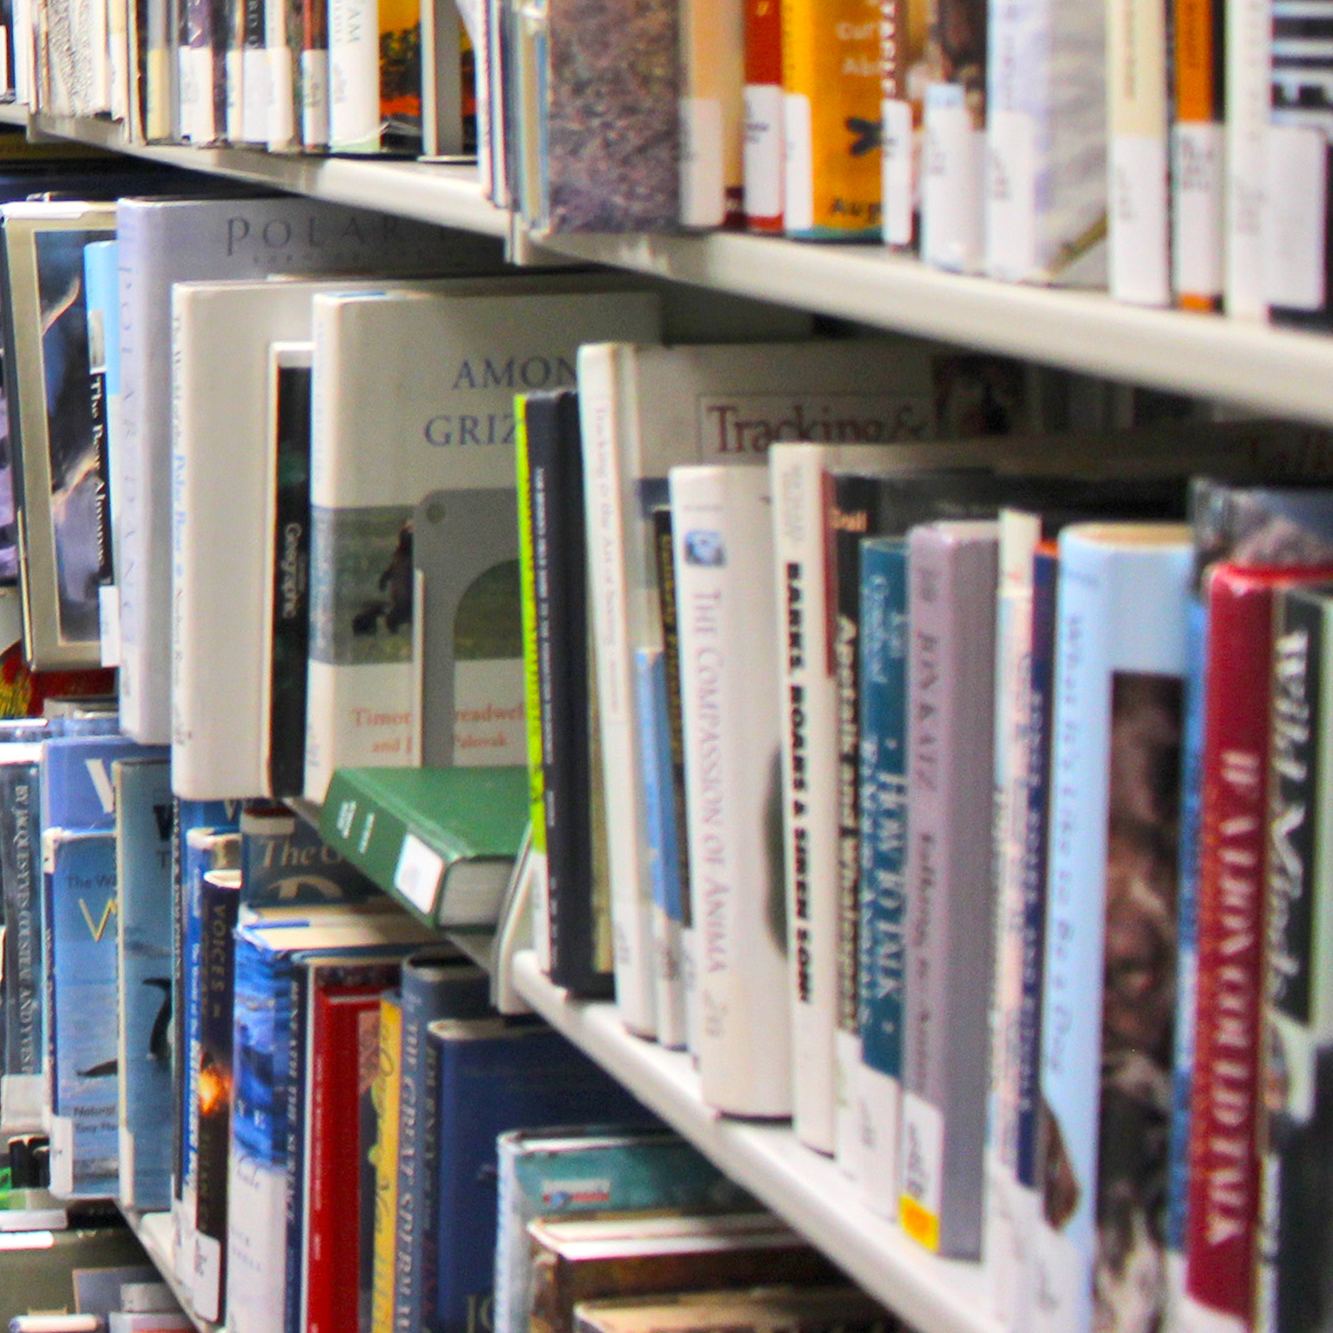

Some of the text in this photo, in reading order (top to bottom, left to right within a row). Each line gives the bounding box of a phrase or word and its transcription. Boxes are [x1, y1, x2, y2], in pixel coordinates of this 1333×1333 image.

[90, 373, 103, 419] The
[693, 590, 723, 636] THE
[837, 615, 858, 756] Apetalk
[697, 647, 726, 830] COMPASSION
[701, 834, 727, 866] OF
[211, 903, 226, 993] VOICES
